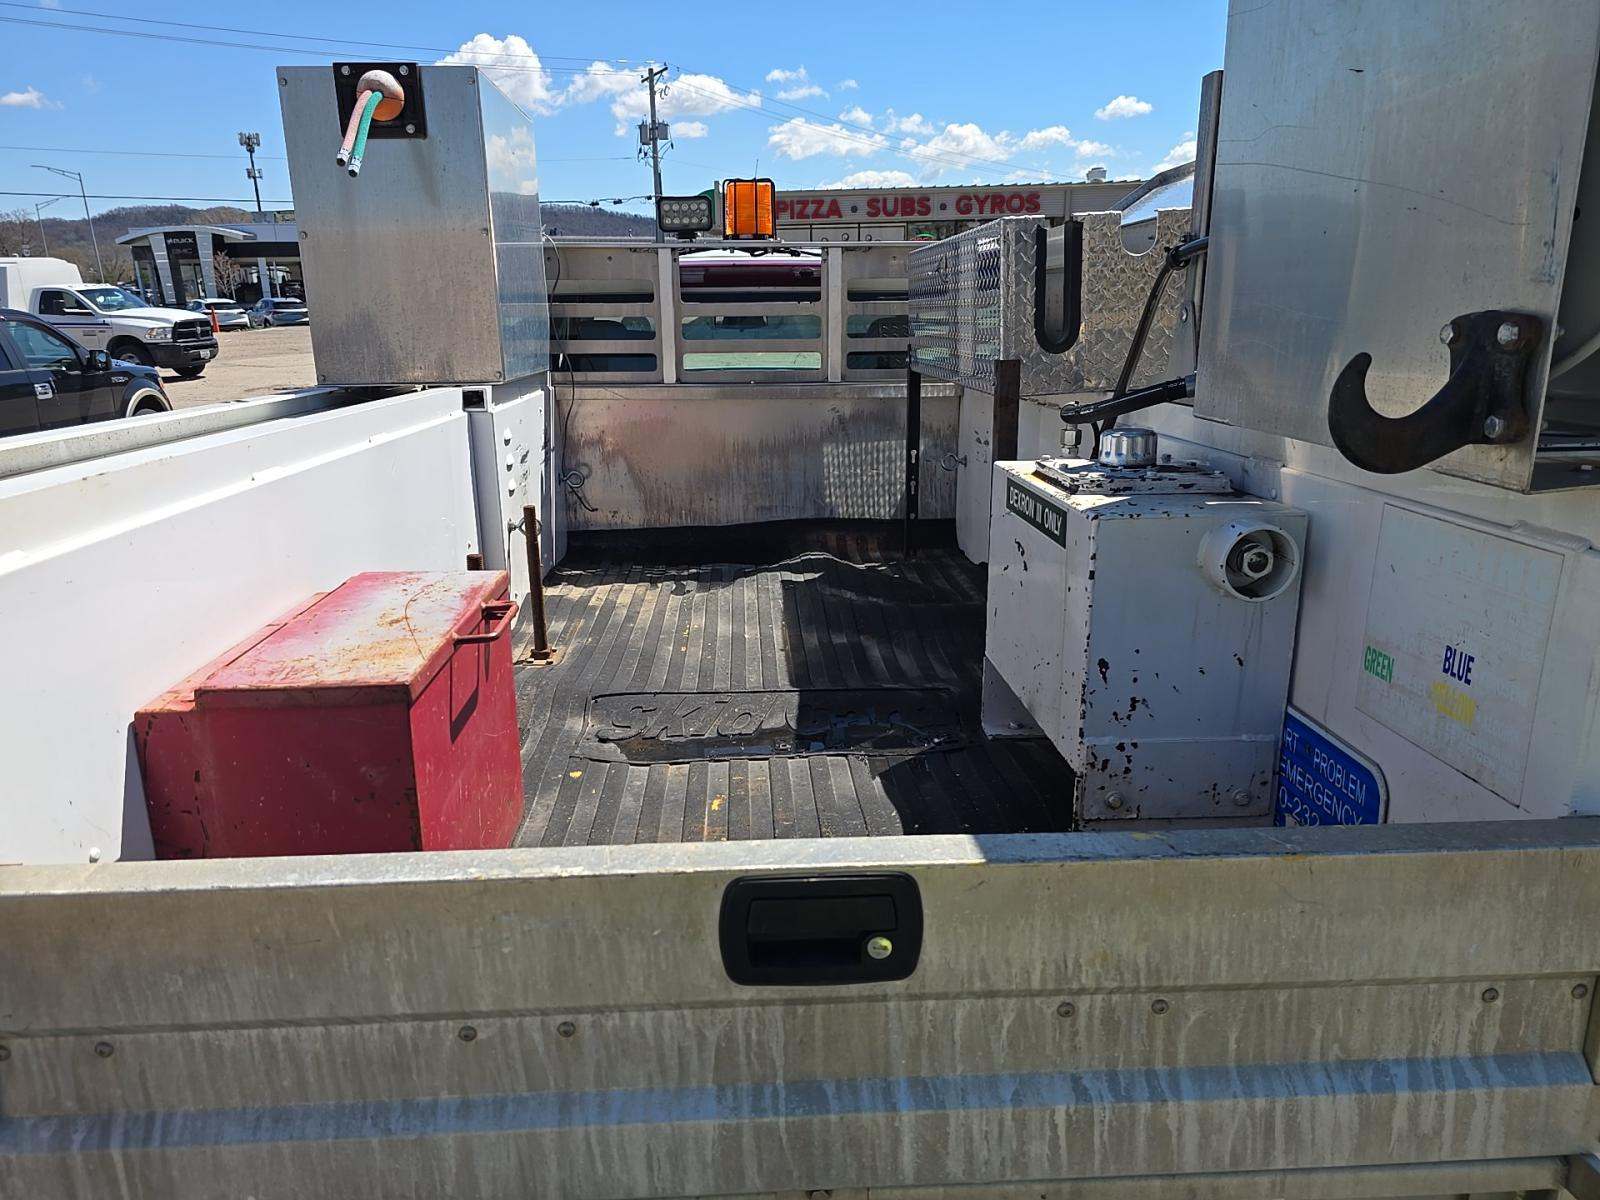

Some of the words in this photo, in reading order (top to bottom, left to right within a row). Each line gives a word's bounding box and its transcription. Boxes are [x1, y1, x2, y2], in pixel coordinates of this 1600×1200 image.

[775, 199, 843, 220] PIZZA
[866, 196, 931, 218] SUBS
[955, 191, 1041, 215] GYROS
[1009, 486, 1035, 519] DEXRON
[1043, 507, 1062, 537] ONLY
[1363, 645, 1395, 684] GREEN
[1442, 645, 1475, 686] BLUE
[1284, 727, 1299, 753] RT
[1313, 748, 1366, 807] PROBLEM
